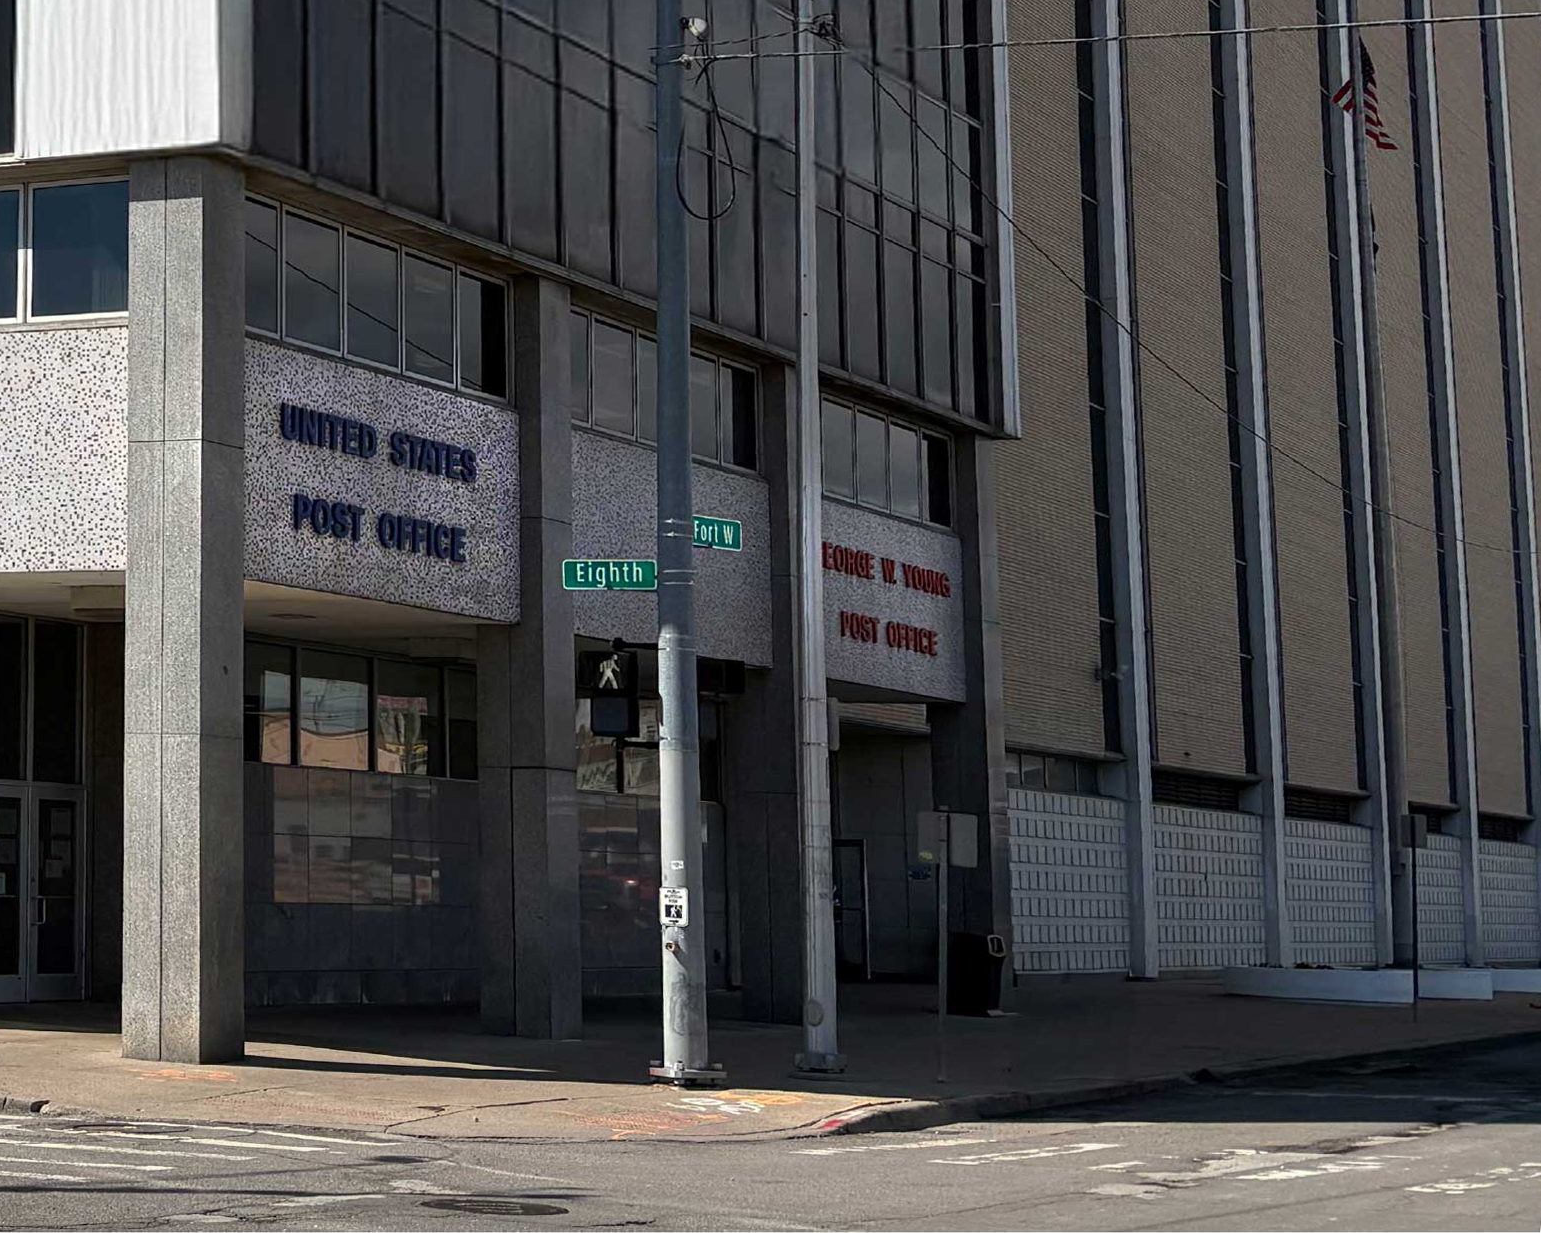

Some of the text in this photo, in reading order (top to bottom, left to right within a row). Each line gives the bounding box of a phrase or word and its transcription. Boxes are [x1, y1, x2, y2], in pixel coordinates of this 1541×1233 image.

[279, 401, 478, 483] UNITED STATES
[293, 493, 467, 562] POST OFFICE
[694, 520, 734, 545] Fort W
[576, 561, 643, 588] Eighth
[821, 540, 951, 598] EORGE W. YOUNG
[840, 610, 938, 657] POST OFFICE
